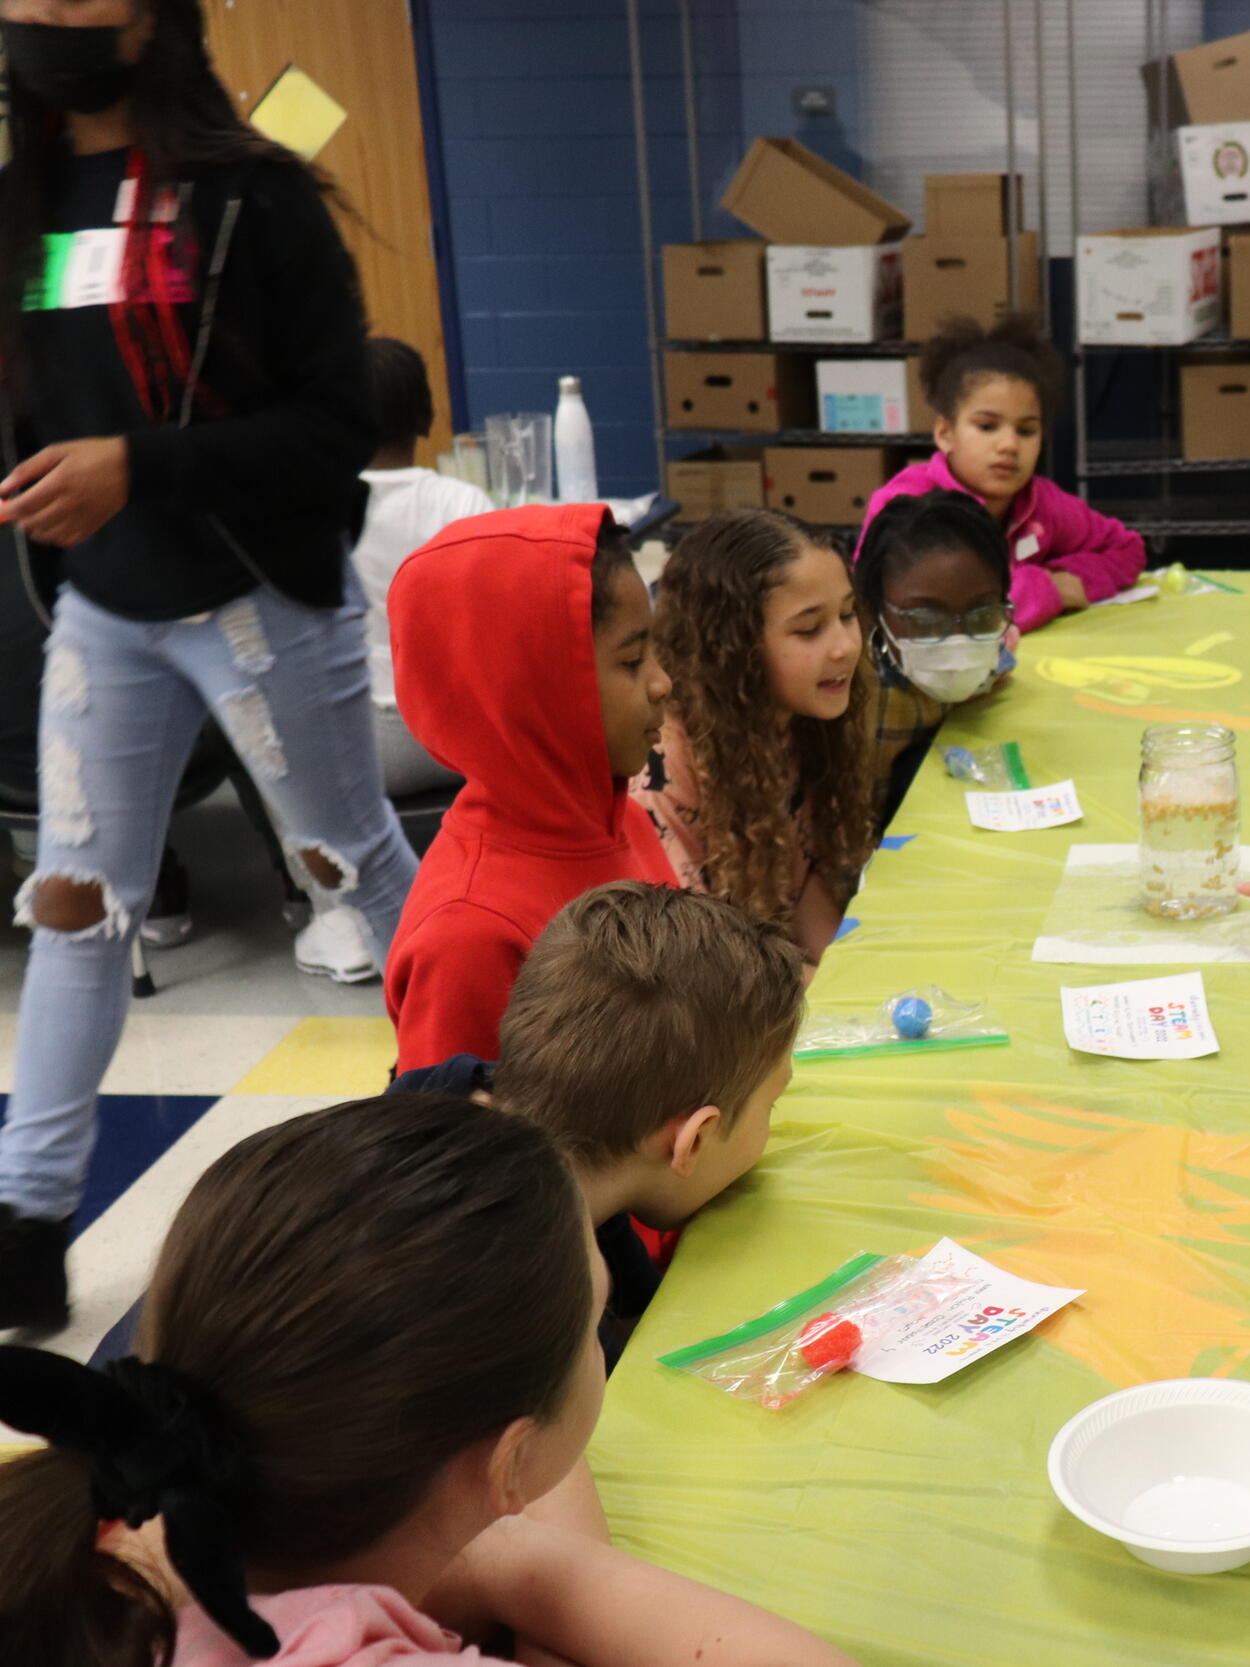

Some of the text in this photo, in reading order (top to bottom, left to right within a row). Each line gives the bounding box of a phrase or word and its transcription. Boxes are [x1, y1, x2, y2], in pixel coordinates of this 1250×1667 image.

[1148, 1006, 1169, 1027] DAY
[1167, 1002, 1193, 1040] STEAM
[945, 1307, 1028, 1356] STEAM
[957, 1305, 1005, 1334] DAY
[922, 1333, 960, 1355] 2022
